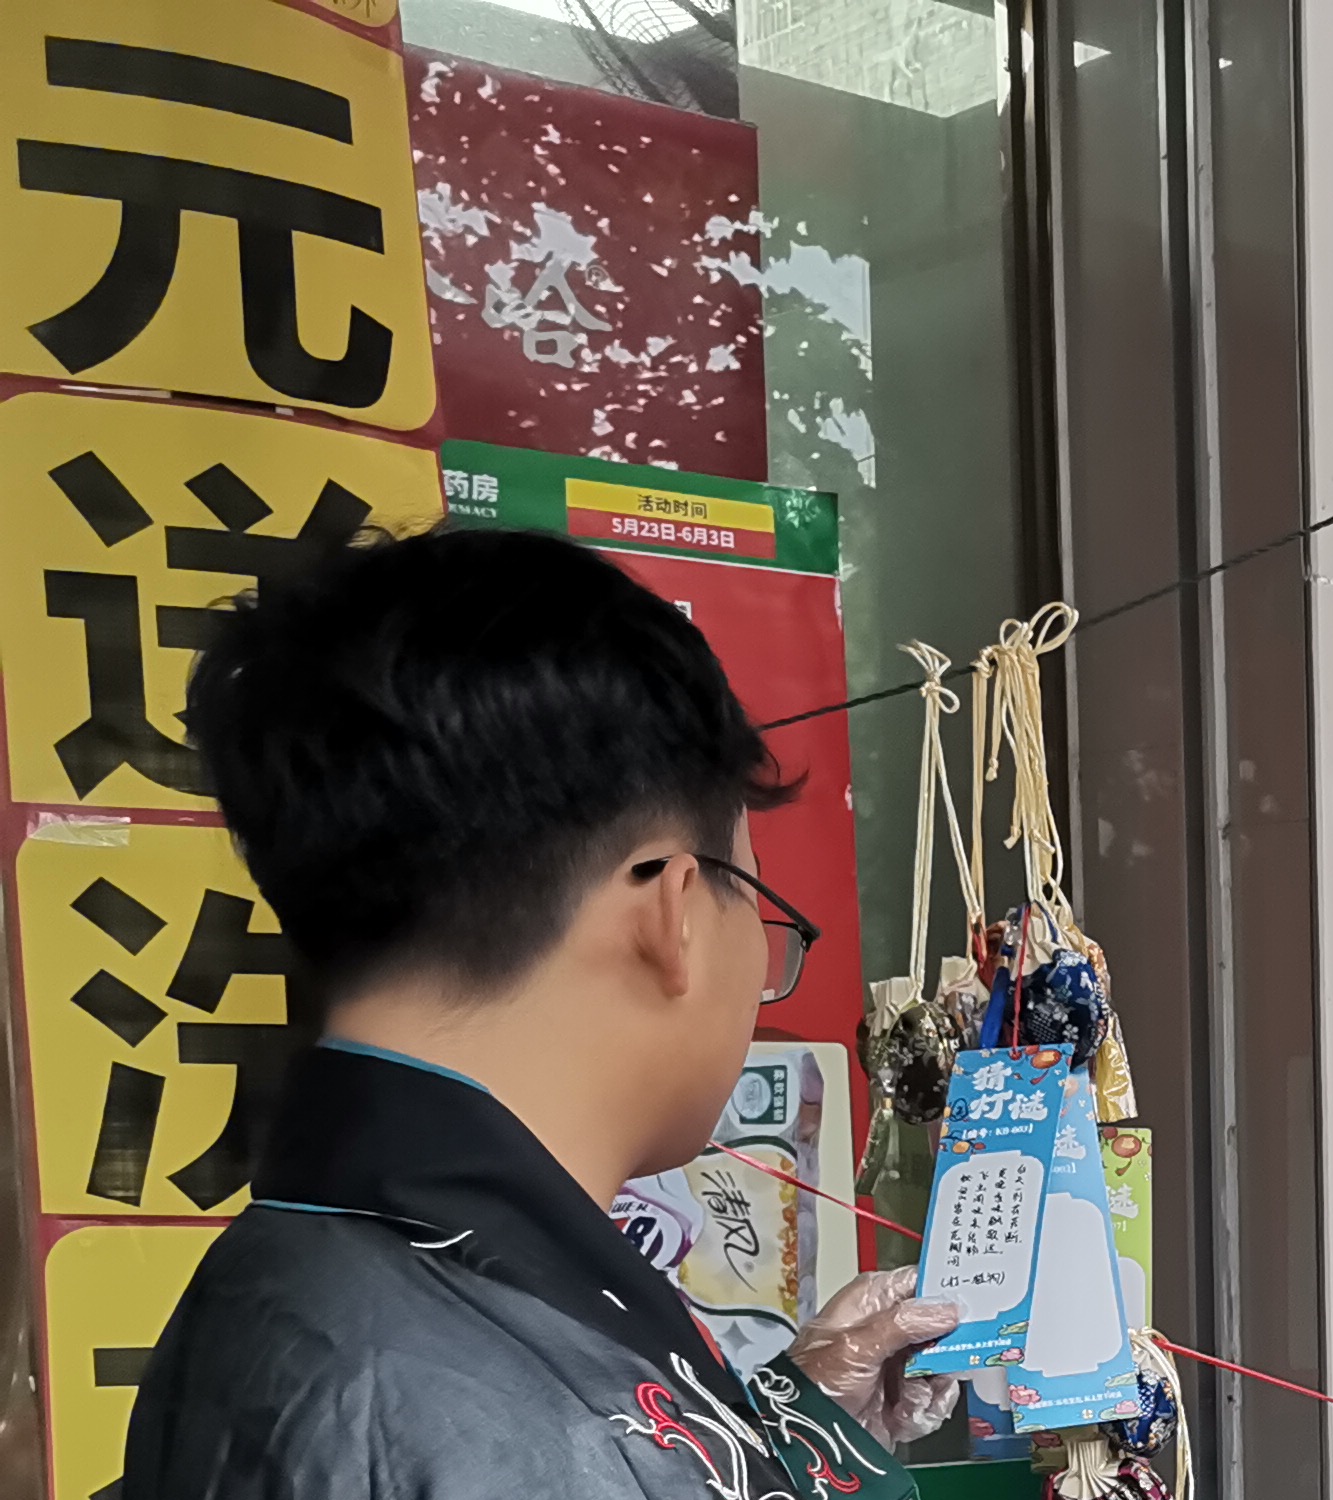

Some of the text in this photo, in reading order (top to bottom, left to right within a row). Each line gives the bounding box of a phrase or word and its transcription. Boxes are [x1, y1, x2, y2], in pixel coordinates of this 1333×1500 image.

[637, 494, 707, 520] 活动时间
[612, 517, 736, 549] 5月23日-6月3日
[972, 1061, 1013, 1091] 猜
[970, 1090, 1048, 1121] 灯谜
